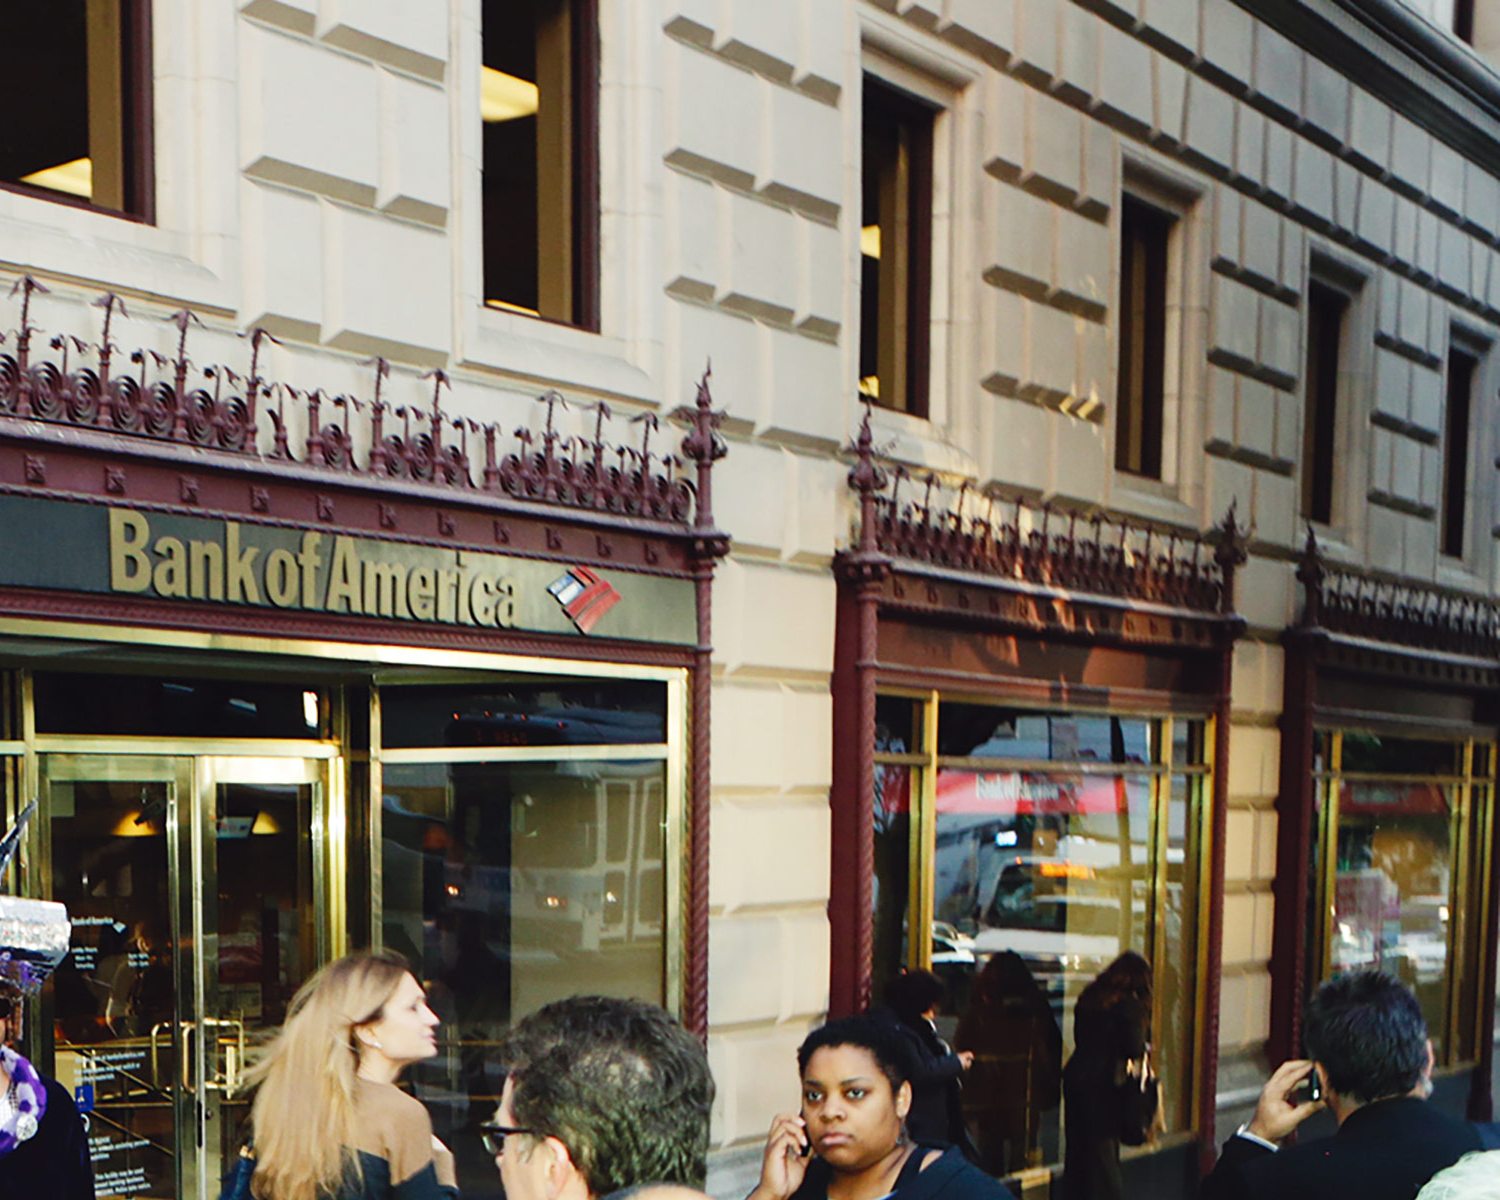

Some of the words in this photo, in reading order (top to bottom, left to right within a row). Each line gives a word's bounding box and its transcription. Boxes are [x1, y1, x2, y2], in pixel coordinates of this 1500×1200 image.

[108, 506, 262, 605] Bank
[264, 529, 323, 609] of
[324, 534, 522, 630] America
